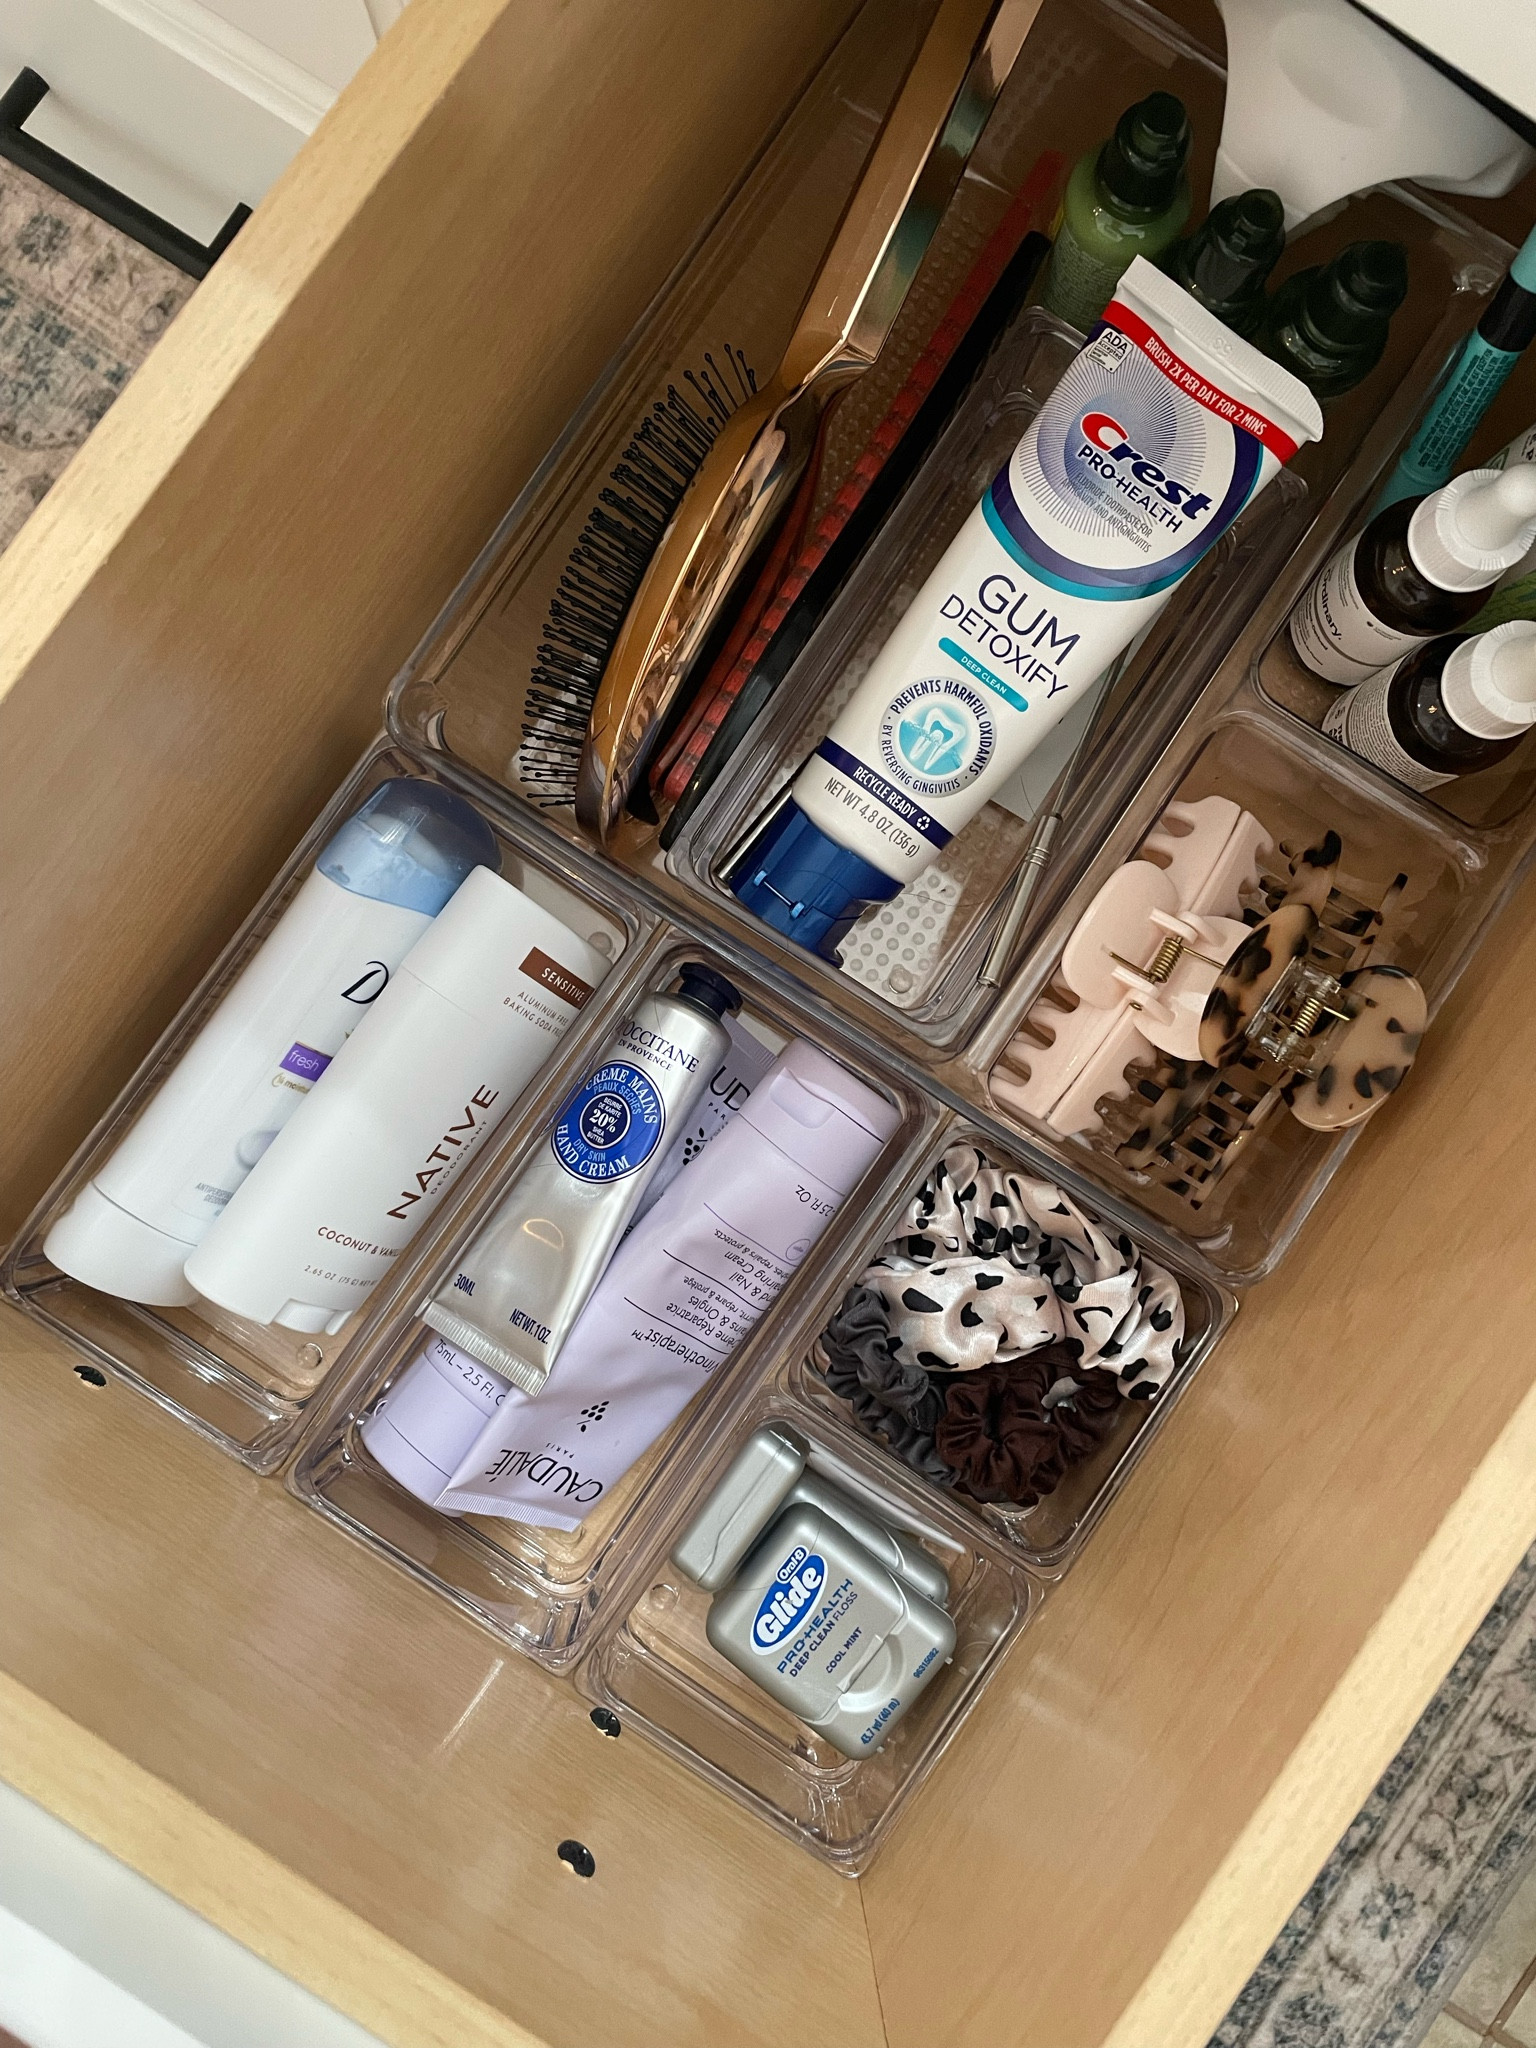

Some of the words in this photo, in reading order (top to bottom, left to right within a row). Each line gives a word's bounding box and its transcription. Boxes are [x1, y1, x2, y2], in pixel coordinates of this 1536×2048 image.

[1096, 339, 1122, 361] Accepted
[1101, 330, 1130, 354] ADA
[1144, 336, 1172, 370] BRUSH
[1168, 360, 1184, 379] 2X
[1179, 371, 1201, 393] PER
[1196, 384, 1219, 407] DAY
[1215, 397, 1237, 418] FOR
[1233, 409, 1245, 422] 2
[1240, 413, 1267, 436] MINS
[1078, 415, 1215, 521] Crest
[1059, 477, 1096, 508] ANTICAVITY
[1091, 501, 1109, 519] AND
[1106, 512, 1152, 553] ANTIGINGIVITIS
[1073, 471, 1105, 500] FLUORIDE
[1101, 492, 1143, 529] TOOTHPASTE
[1137, 521, 1153, 538] FOR
[979, 574, 1081, 666] GUM
[938, 593, 1069, 699] DETOXIFY
[958, 655, 982, 677] DEEP
[979, 671, 1008, 695] CLEAN
[880, 724, 890, 736] BY
[889, 679, 942, 714] PREVENTS
[943, 680, 984, 719] HARMFUL
[968, 720, 991, 777] OXIDANTS
[882, 737, 913, 785] REVERSING
[851, 765, 890, 800] RECYCLE
[885, 790, 918, 820] READY
[911, 778, 960, 794] GINGIVITIS
[823, 776, 846, 798] NET
[841, 789, 863, 811] WT
[857, 801, 879, 823] 4.8
[874, 815, 893, 835] OZ
[887, 825, 910, 849] (136
[903, 839, 921, 858] g)
[540, 967, 585, 1001] SENSITIVE
[503, 996, 535, 1021] BAKING
[535, 1016, 552, 1031] SODA
[517, 991, 556, 1019] ALUMINUM
[556, 1014, 568, 1026] FREE
[287, 1049, 320, 1072] fresh
[626, 1043, 672, 1071] PROVENCE
[593, 1082, 618, 1094] PEAUX
[618, 1085, 641, 1115] SECHES
[603, 1097, 622, 1110] BEURRE
[628, 1075, 656, 1124] MAINS
[588, 1108, 618, 1133] 20%
[591, 1126, 604, 1136] SHEA
[386, 1082, 499, 1220] NATIVE
[556, 1123, 579, 1165] HAND
[579, 1155, 630, 1177] CREAM
[572, 1138, 588, 1156] DRY
[587, 1151, 606, 1160] SKIN
[586, 1131, 604, 1144] BUTTER
[430, 1119, 487, 1195] DEODORANT
[794, 1184, 811, 1204] Oz.
[810, 1197, 823, 1211] Fl.
[316, 1225, 371, 1252] COCONUT
[370, 1246, 377, 1254] &
[713, 1228, 744, 1250] protects.
[741, 1246, 750, 1254] &
[304, 1264, 323, 1276] 2.65
[324, 1270, 336, 1280] OZ
[723, 1250, 754, 1274] Cream
[748, 1250, 773, 1269] repairs
[453, 1273, 475, 1296] 30ML
[681, 1275, 710, 1296] protège.
[707, 1290, 715, 1298] &
[728, 1271, 752, 1291] Nail
[749, 1286, 761, 1298] &
[686, 1295, 720, 1321] Ongles
[713, 1294, 738, 1314] répare
[757, 1291, 774, 1305] and
[664, 1302, 715, 1336] Réparatrice
[718, 1314, 730, 1326] &
[729, 1321, 748, 1335] ains
[434, 1338, 457, 1366] 75mL
[462, 1365, 482, 1386] 2.5
[479, 1380, 496, 1398] Fl.
[544, 1441, 574, 1458] PARIS
[483, 1447, 603, 1504] CAUDALÍE
[755, 1565, 821, 1642] Glide
[788, 1650, 811, 1677] DEEP
[807, 1619, 835, 1652] CLEAN
[832, 1590, 858, 1621] FLOSS
[825, 1648, 846, 1673] COOL
[843, 1626, 863, 1649] MINT
[860, 1726, 875, 1745] 43.7
[869, 1716, 882, 1732] yd
[876, 1706, 892, 1722] (40
[886, 1696, 900, 1711] m)
